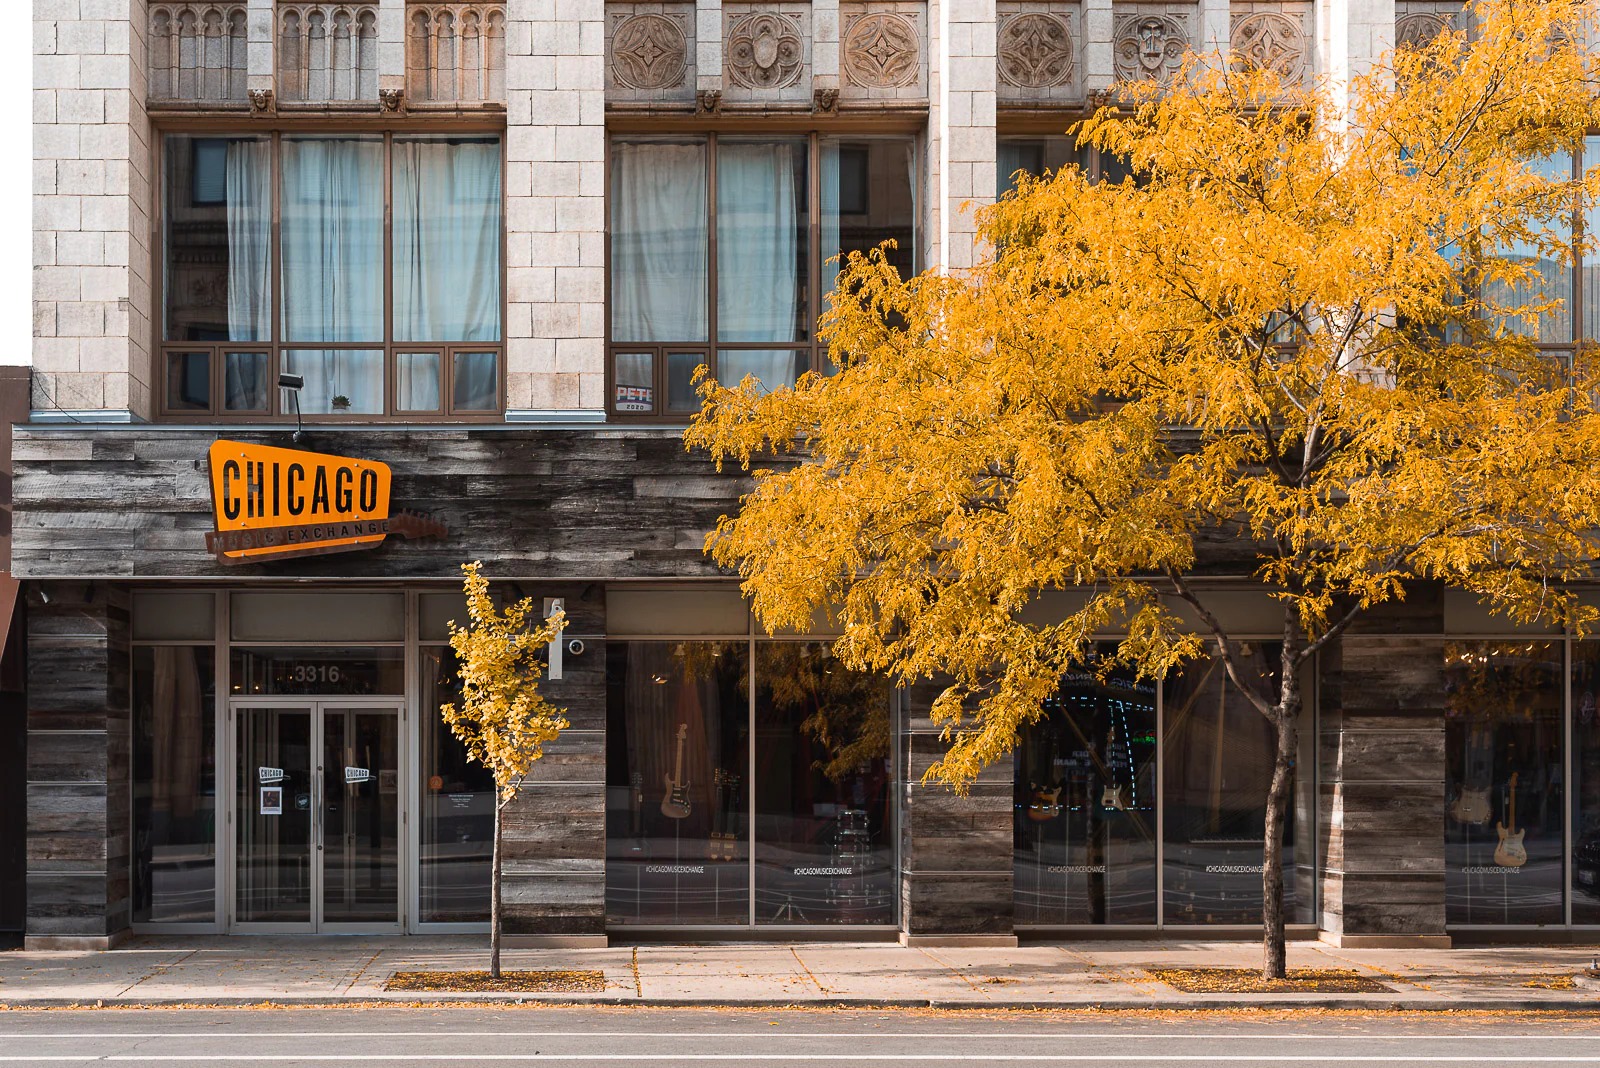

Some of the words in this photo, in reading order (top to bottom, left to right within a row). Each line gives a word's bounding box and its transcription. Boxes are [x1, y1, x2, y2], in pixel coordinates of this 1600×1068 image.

[617, 386, 652, 402] PETE
[223, 459, 378, 521] CHICAGO
[288, 521, 389, 541] EXCHANGE
[295, 665, 340, 683] 3316
[260, 769, 282, 778] CHICAGO
[346, 769, 368, 778] CHICAGO
